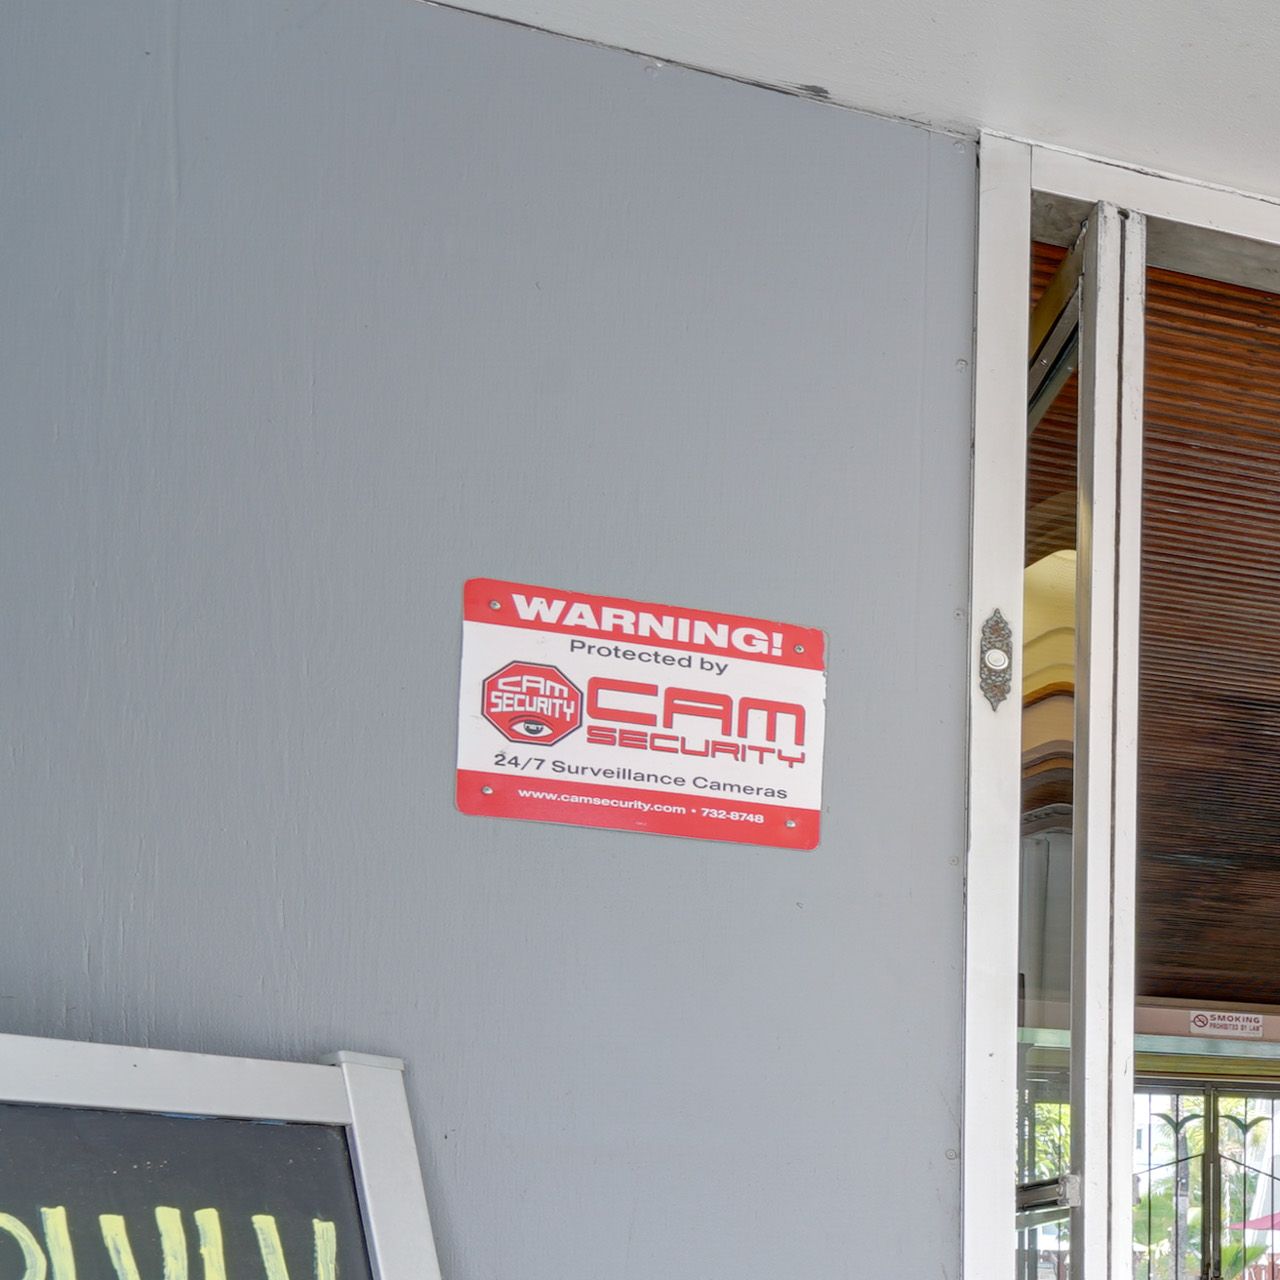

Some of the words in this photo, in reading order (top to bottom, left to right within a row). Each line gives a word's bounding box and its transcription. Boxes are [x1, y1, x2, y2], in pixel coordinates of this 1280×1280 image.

[511, 593, 784, 657] WARNING!
[569, 639, 692, 670] Protected
[700, 655, 729, 676] by
[497, 674, 569, 699] CAM
[489, 689, 575, 723] SECURITY
[586, 676, 806, 746] CAM
[586, 726, 806, 769] SECURITY
[494, 752, 546, 774] 24/7
[551, 760, 686, 788] Surveillance
[692, 776, 788, 800] Cameras
[518, 789, 687, 816] www.camsecurity.com
[701, 807, 765, 825] 732-8748
[1210, 1014, 1260, 1024] SMOKING
